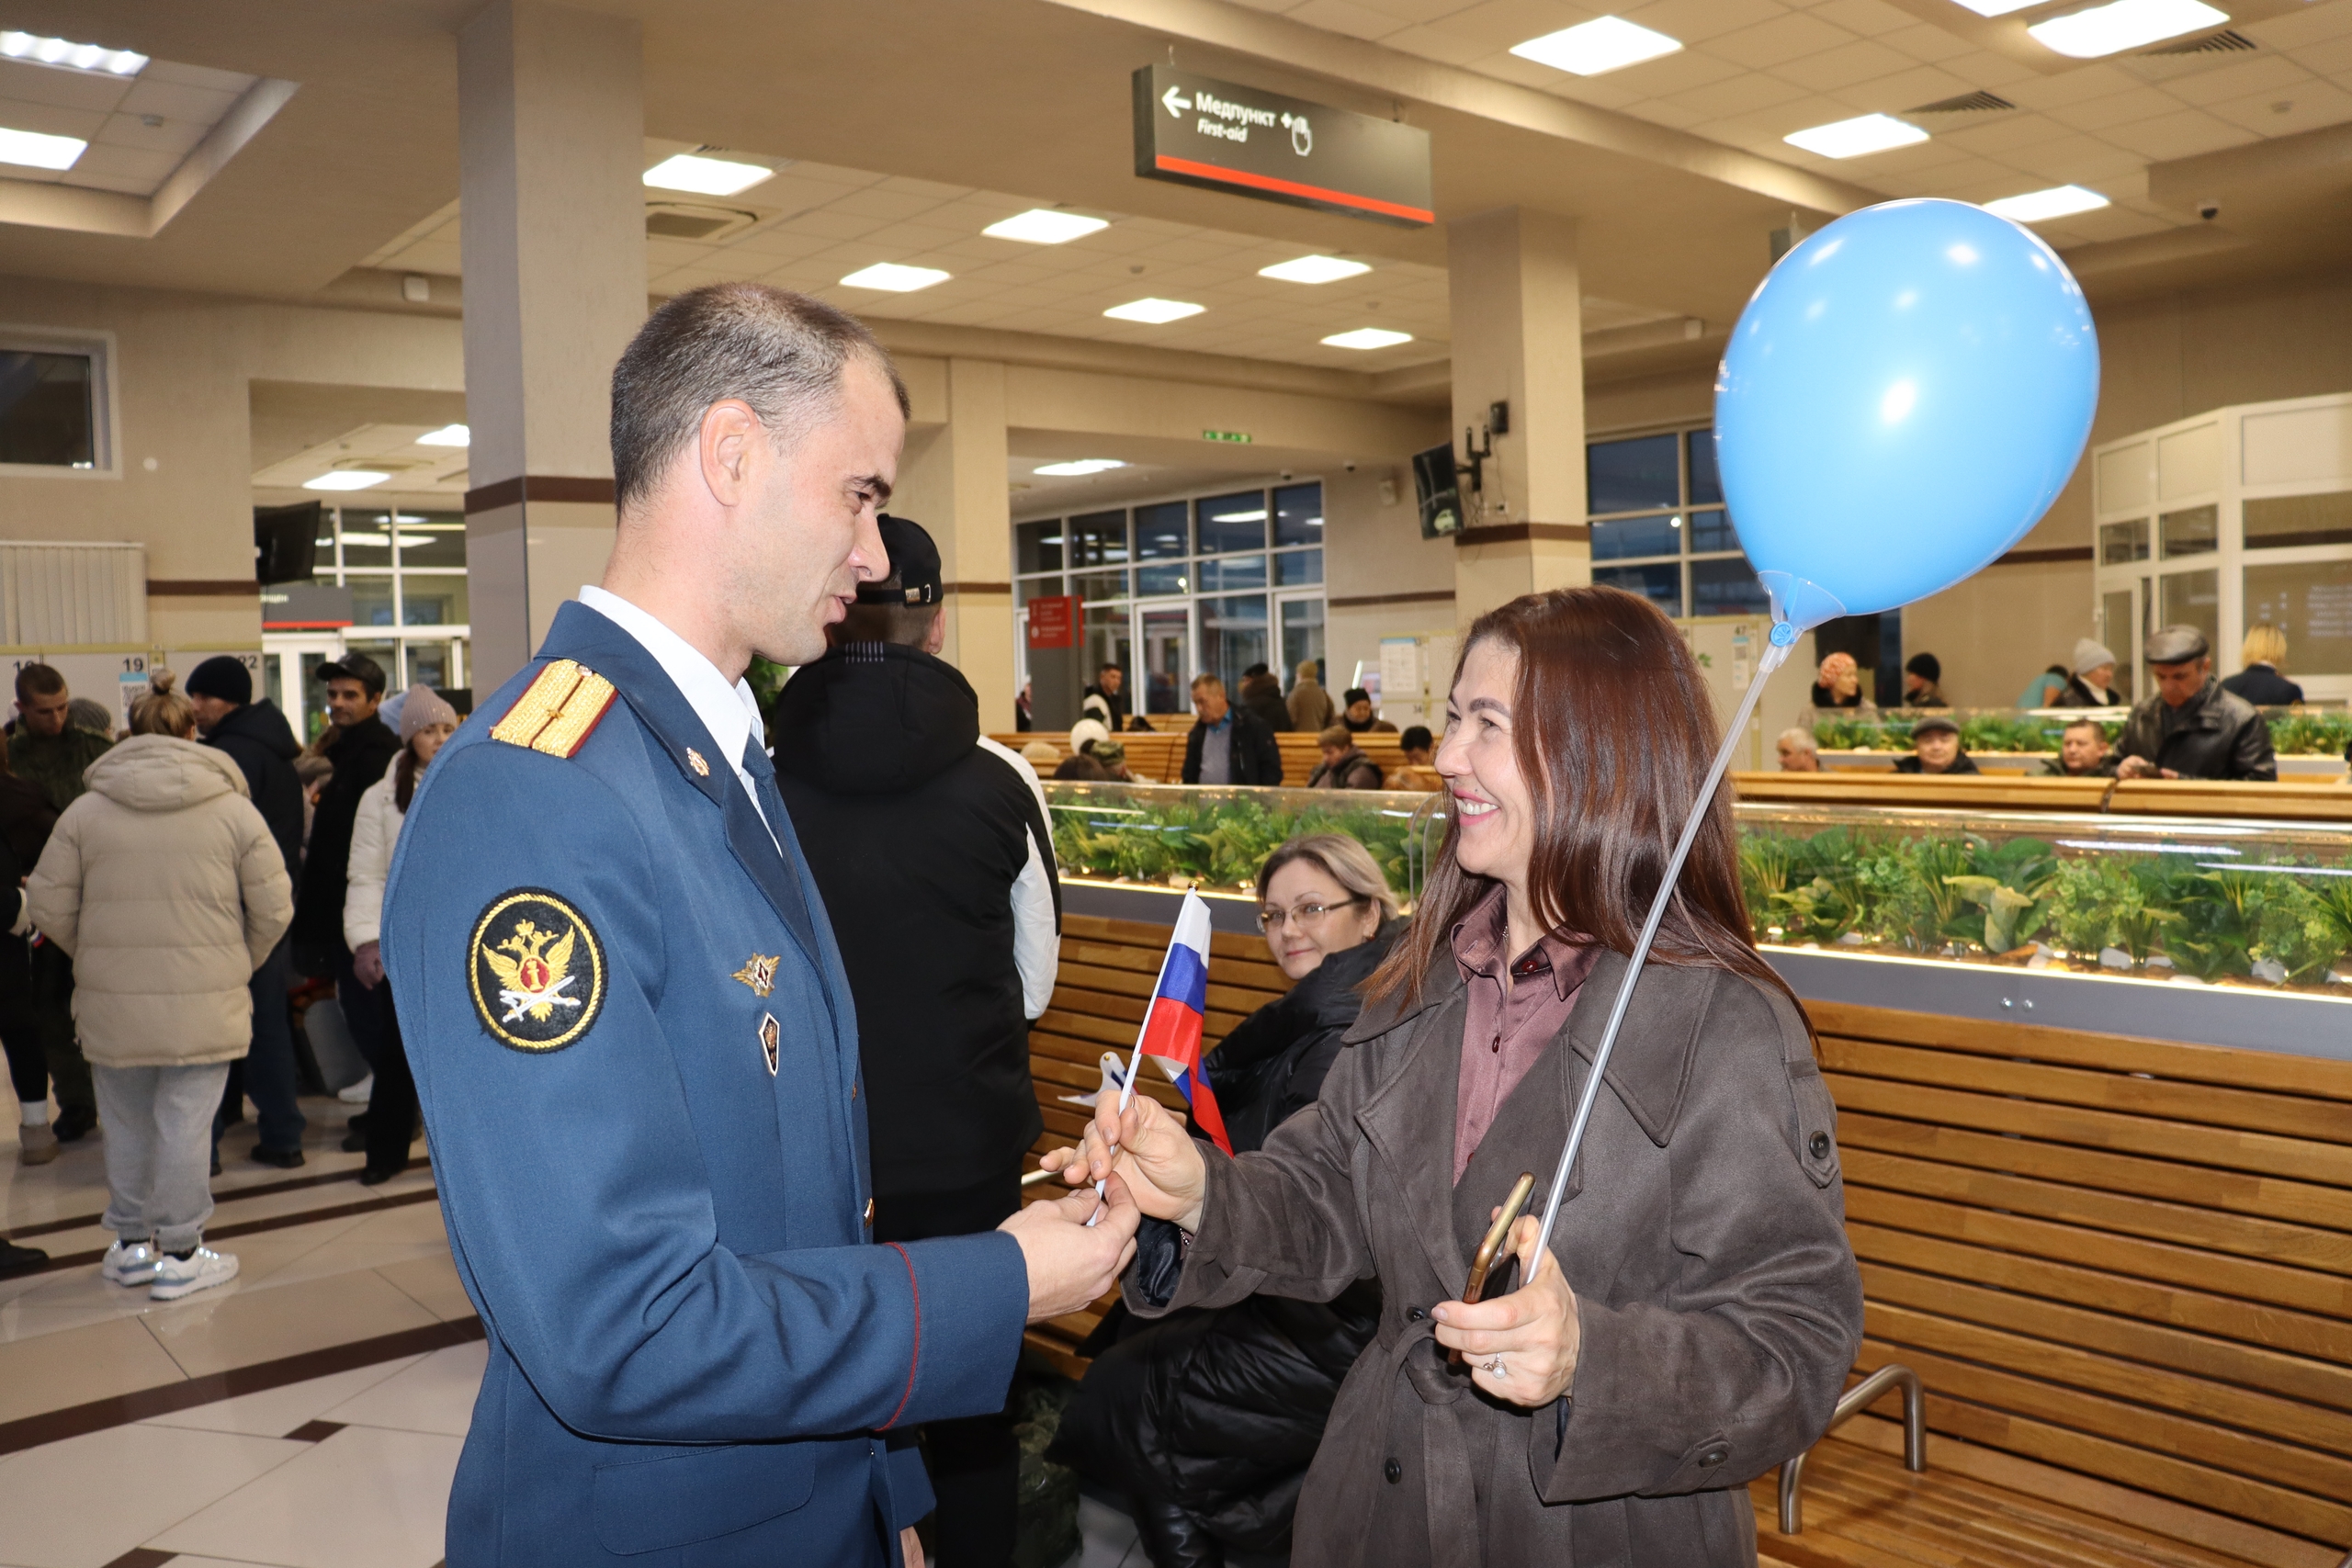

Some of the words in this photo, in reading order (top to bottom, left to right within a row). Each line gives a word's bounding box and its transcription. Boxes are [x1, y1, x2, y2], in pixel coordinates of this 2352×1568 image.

[1196, 92, 1276, 127] Медпункт
[1197, 118, 1248, 142] First-aid
[122, 658, 143, 671] 19
